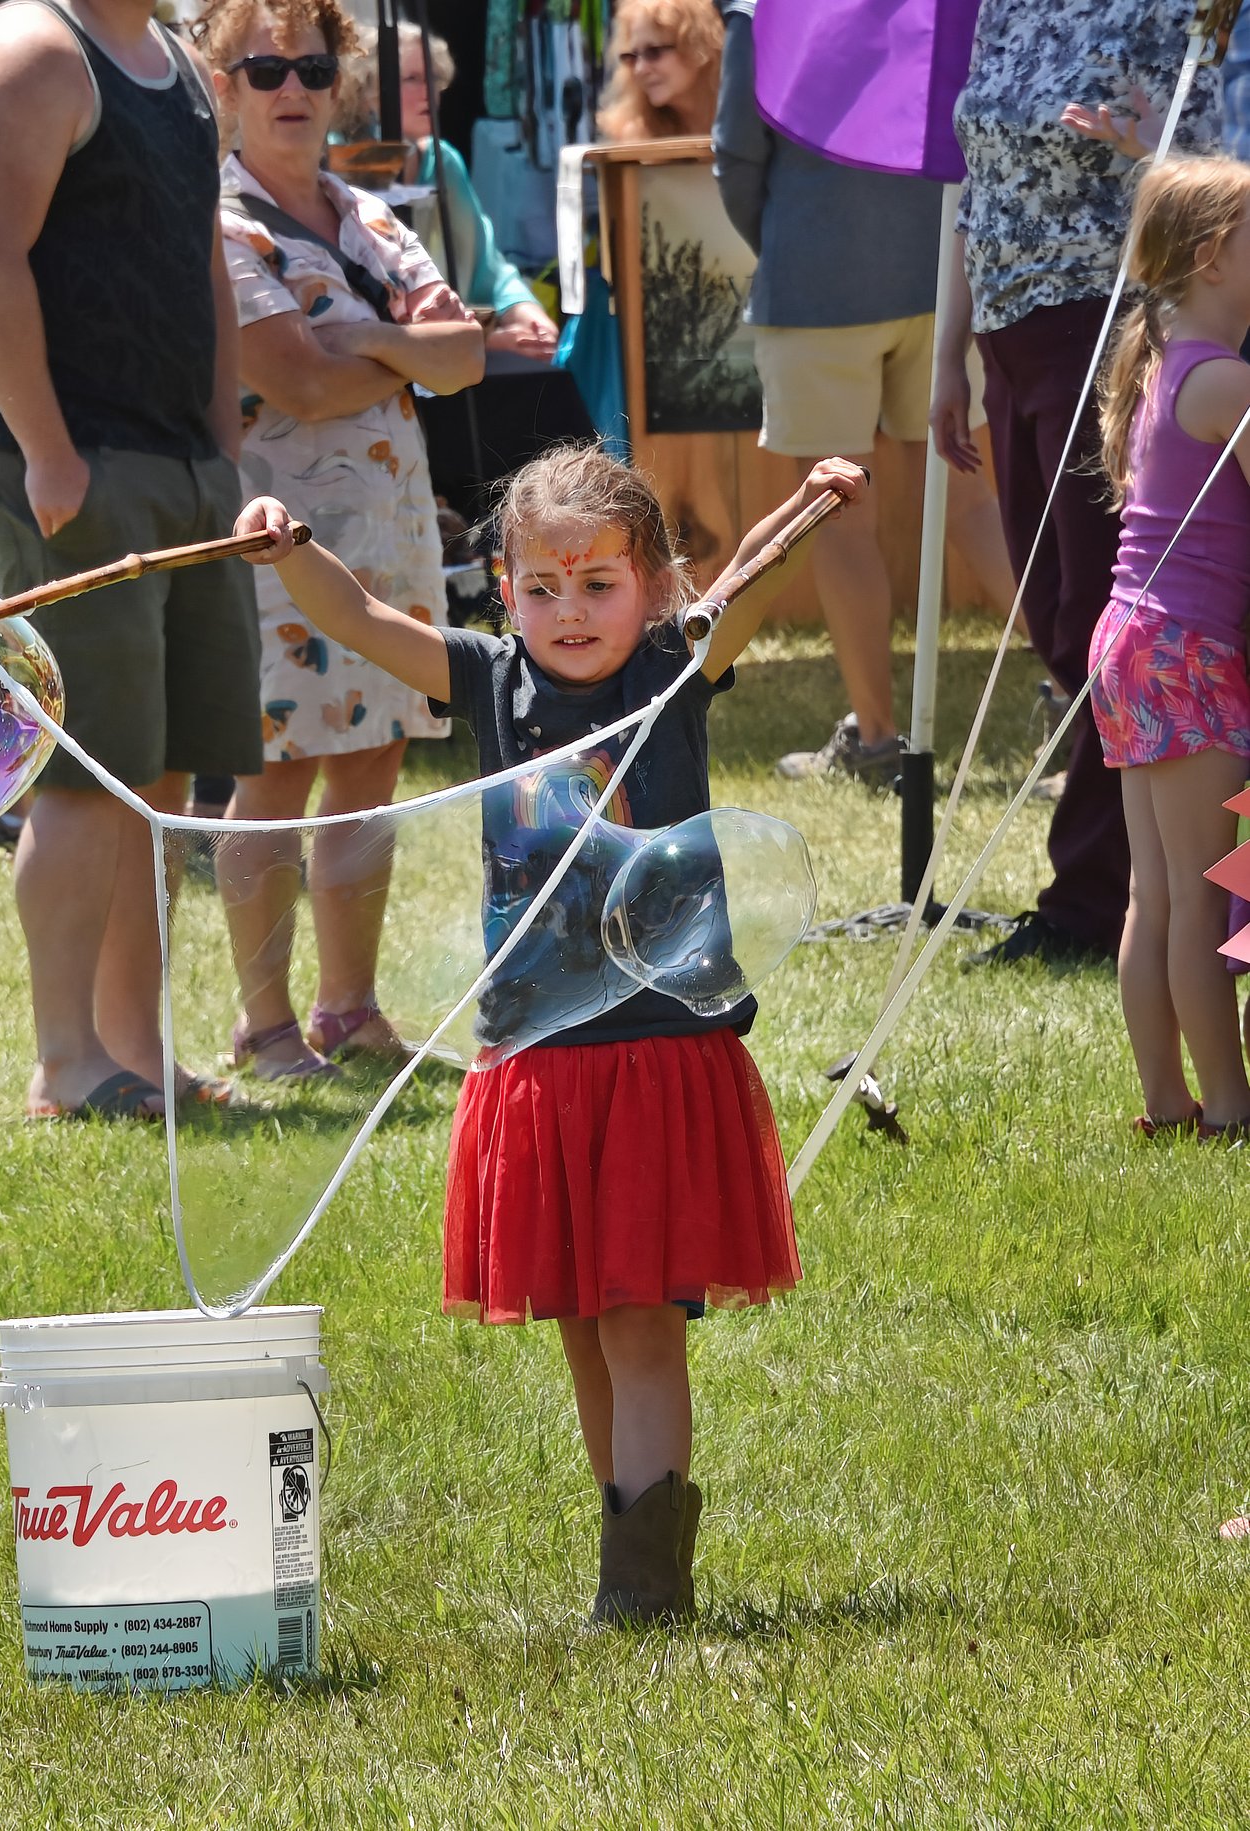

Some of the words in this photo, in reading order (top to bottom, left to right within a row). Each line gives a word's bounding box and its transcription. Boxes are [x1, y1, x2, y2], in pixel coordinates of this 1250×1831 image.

[49, 1620, 72, 1633] Home
[74, 1619, 109, 1635] Supply
[124, 1619, 151, 1634] (802)
[153, 1616, 202, 1630] 434-2887
[121, 1644, 147, 1659] (802)
[150, 1641, 199, 1656] 244-8905
[133, 1666, 159, 1682] (802)
[162, 1664, 209, 1679] 878-3301
